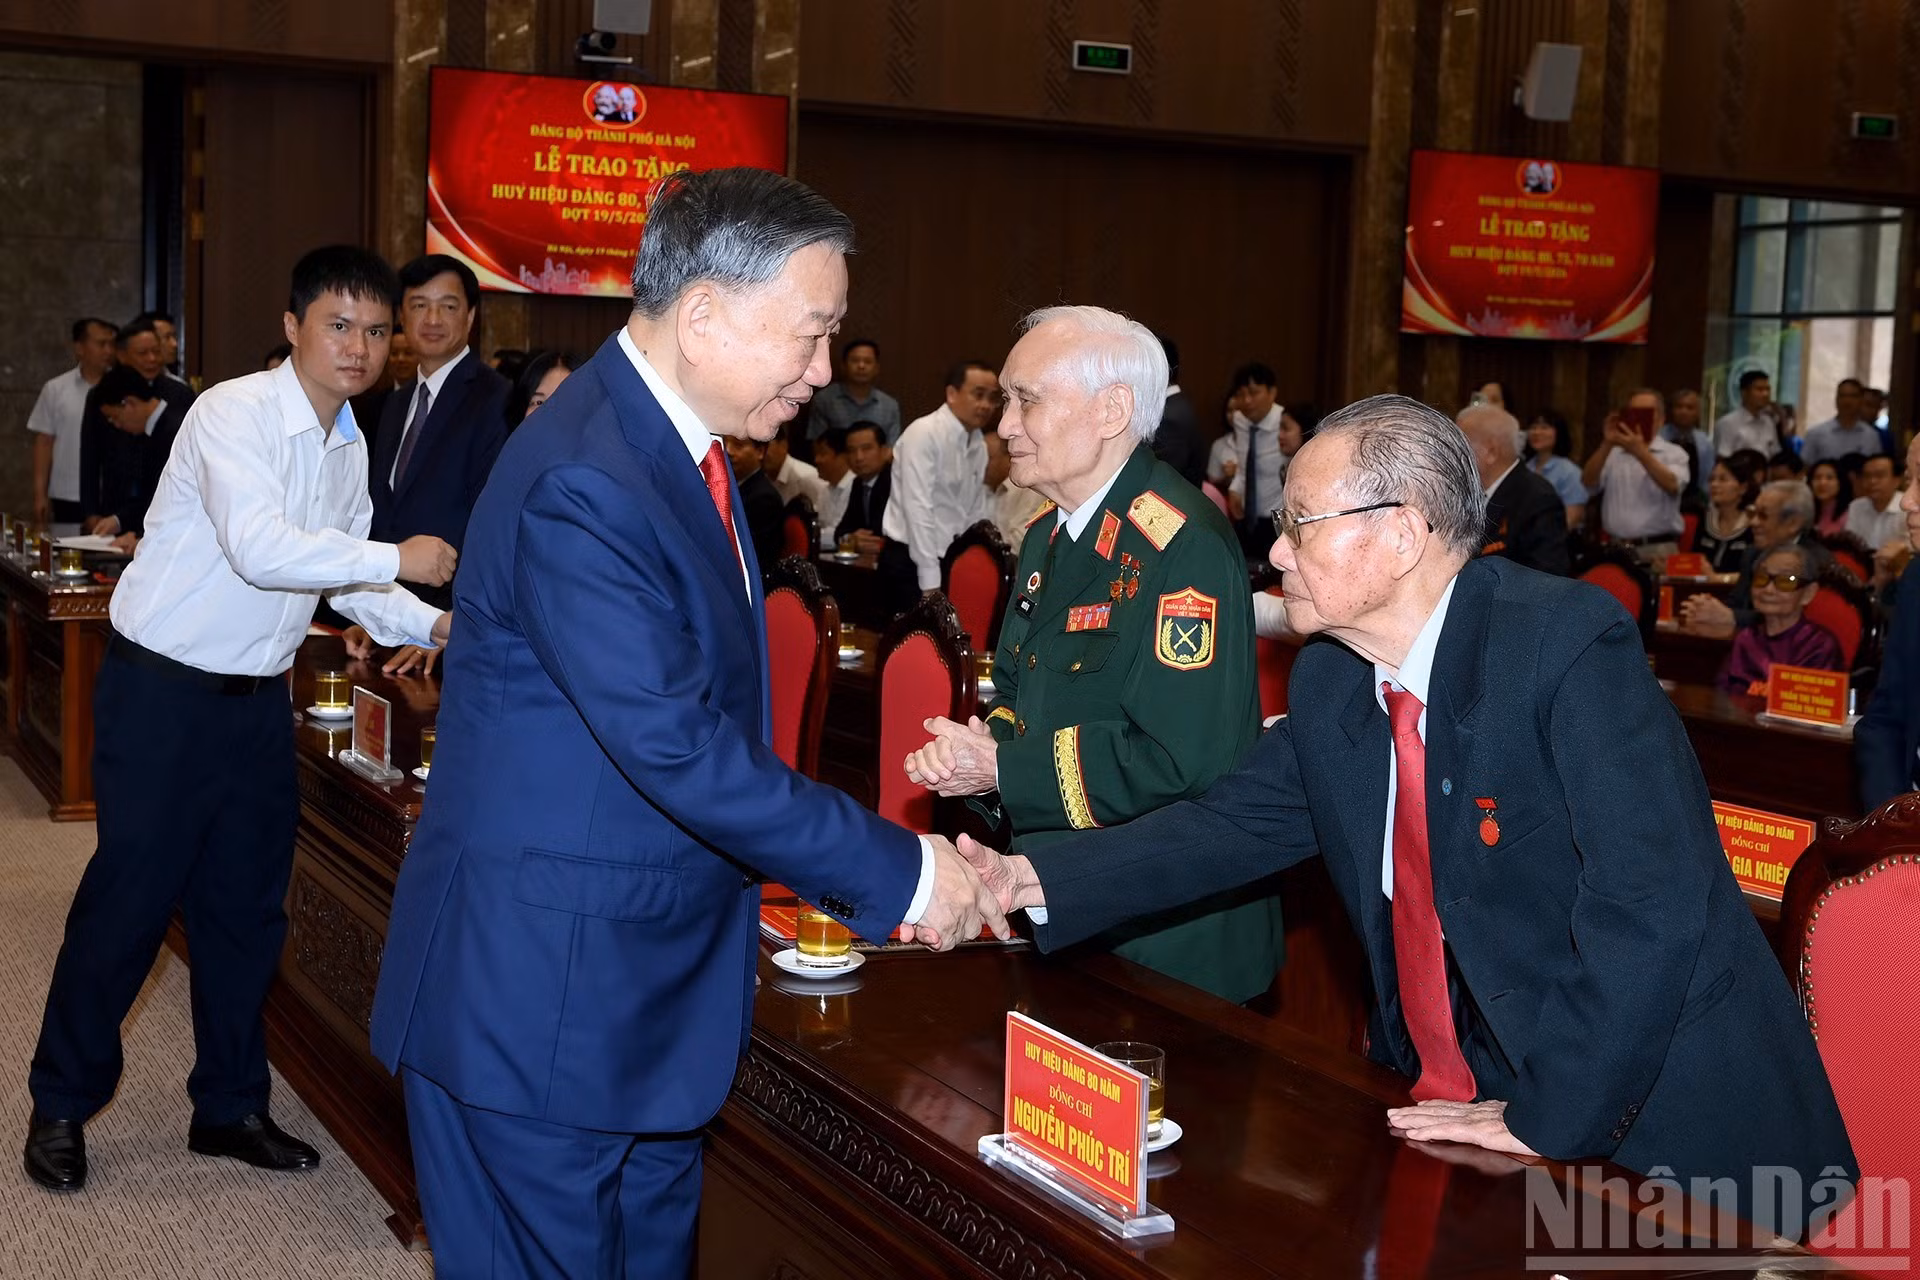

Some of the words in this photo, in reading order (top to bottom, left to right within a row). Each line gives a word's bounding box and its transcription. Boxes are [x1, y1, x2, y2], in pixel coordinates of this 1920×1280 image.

[566, 126, 583, 140] BỘ
[628, 130, 653, 144] PHỐ
[656, 132, 672, 147] HÀ
[674, 134, 696, 150] NỘI
[534, 145, 561, 172] LỄ
[566, 154, 627, 177] TRAO
[492, 184, 526, 200] HUY
[529, 184, 568, 205] HIỆU
[571, 187, 614, 205] ĐẢNG
[618, 192, 642, 209] 80,
[1503, 218, 1546, 239] TRAO
[1714, 814, 1724, 826] UY
[1725, 816, 1742, 832] HIỆU
[1744, 818, 1764, 834] ĐẢNG
[1766, 824, 1776, 836] 80
[1776, 826, 1795, 841] NĂM
[1755, 842, 1770, 854] CHÍ
[1732, 855, 1753, 878] GIA
[1025, 1040, 1041, 1066] HUY
[1042, 1048, 1061, 1074] HIỆU
[1062, 1057, 1086, 1087] ĐẢNG
[1087, 1071, 1098, 1092] 80
[1100, 1077, 1121, 1104] NĂM
[1049, 1084, 1074, 1110] ĐỒNG
[1076, 1100, 1093, 1120] CHÍ
[1014, 1095, 1065, 1151] NGUYỄN
[1068, 1126, 1104, 1173] PHÚC
[1107, 1146, 1130, 1188] TRÍ
